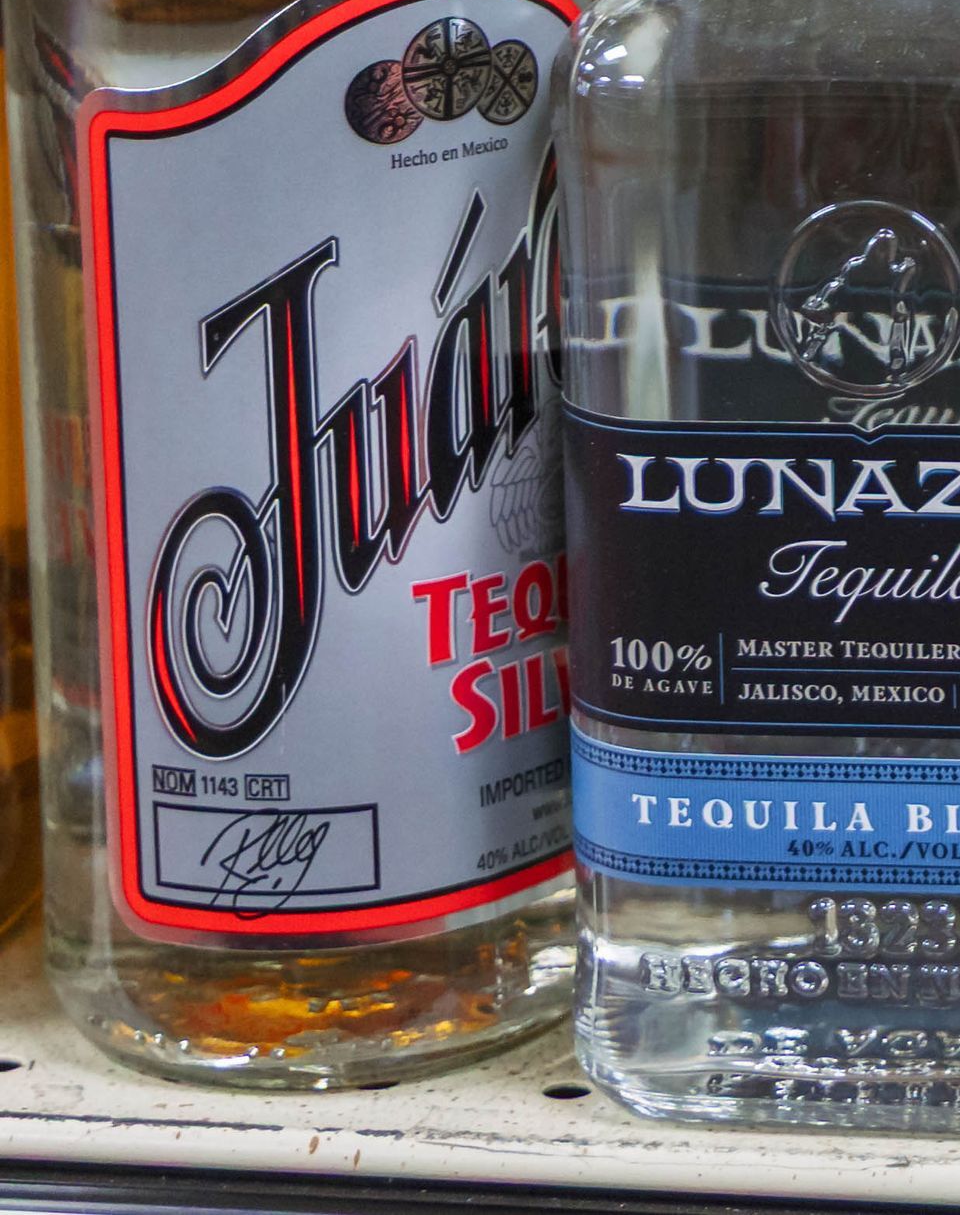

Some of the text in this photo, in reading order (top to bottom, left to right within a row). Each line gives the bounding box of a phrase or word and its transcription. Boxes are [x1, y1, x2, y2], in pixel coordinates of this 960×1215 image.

[391, 137, 508, 170] Hecho en Mexico
[610, 636, 713, 673] 100%
[737, 639, 832, 661] MASTER
[611, 673, 714, 696] DE AGAVE
[738, 683, 946, 705] JALISCO, MEXICO
[152, 768, 285, 798] NOM 1143 CRT
[480, 757, 564, 807] IMPORTED
[632, 792, 875, 833] TEQUILA
[477, 847, 508, 871] 40%
[787, 838, 835, 857] 40%
